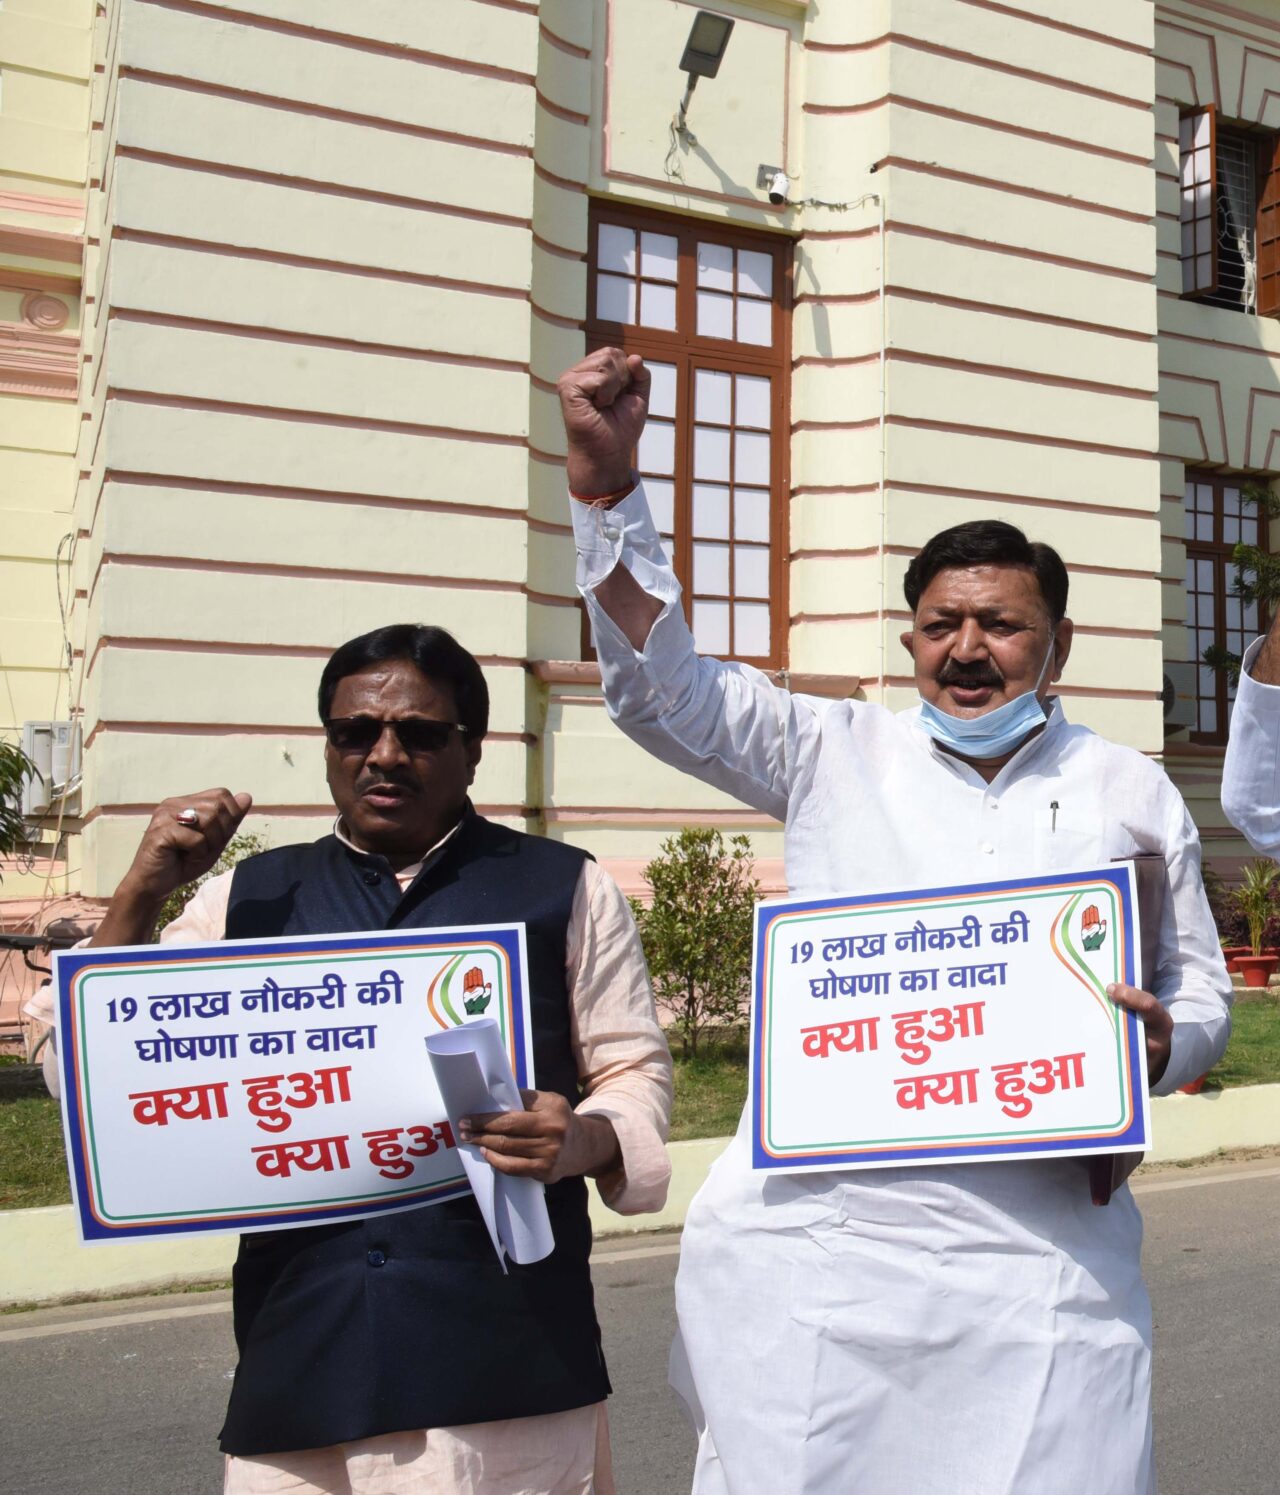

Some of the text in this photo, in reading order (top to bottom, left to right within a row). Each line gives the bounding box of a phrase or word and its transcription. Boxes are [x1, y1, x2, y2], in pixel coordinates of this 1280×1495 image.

[790, 911, 1028, 965] 19 लाख नौकरी की
[108, 970, 403, 1022] 19 लाख नौकरी की
[810, 963, 1006, 998] घोषणा का वादा
[135, 1025, 376, 1062] घोषणा का वादा
[801, 1002, 985, 1065] क्या हुआ
[129, 1066, 352, 1133] क्या हुआ
[895, 1053, 1085, 1118] क्या हुआ
[252, 1136, 350, 1177] क्या
